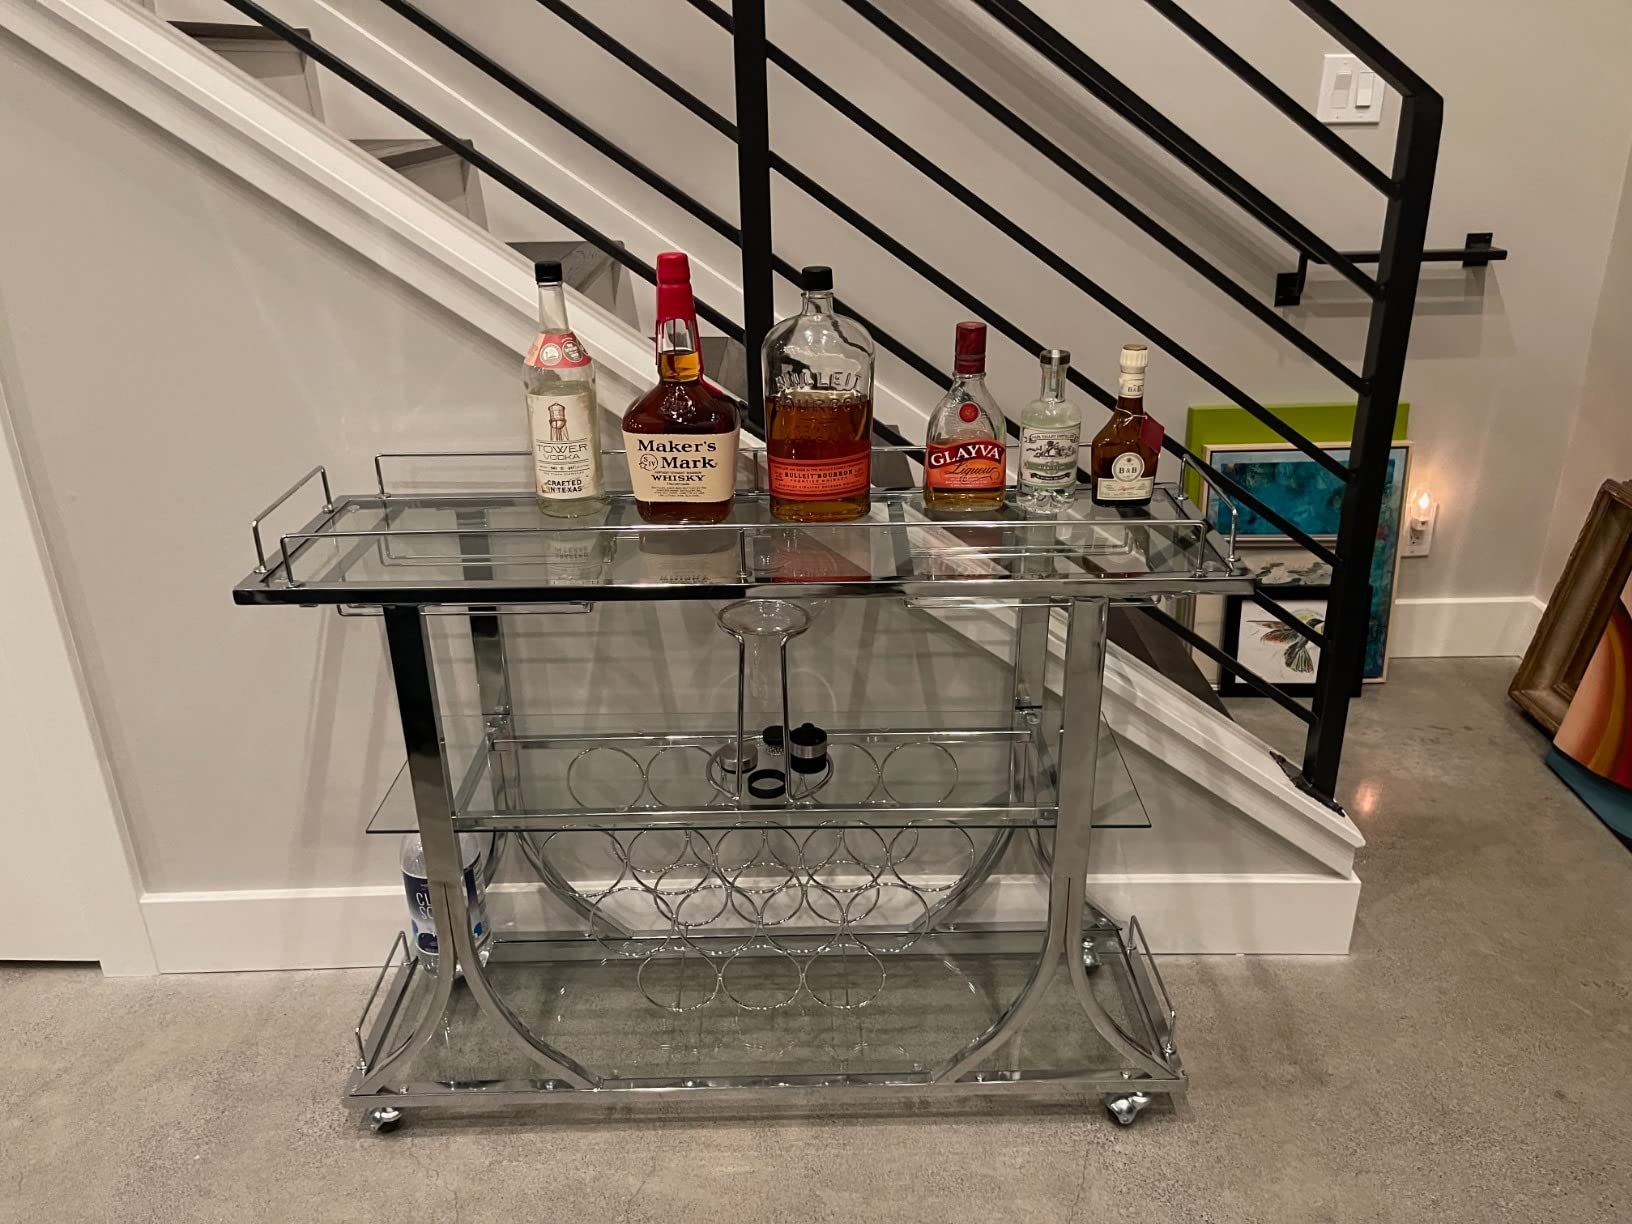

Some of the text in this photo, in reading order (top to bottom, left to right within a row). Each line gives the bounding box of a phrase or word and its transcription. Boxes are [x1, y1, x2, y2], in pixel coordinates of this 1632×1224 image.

[536, 443, 588, 453] TOWER
[637, 439, 717, 453] Maker's
[930, 444, 1001, 466] GLAYVA
[661, 457, 717, 469] Mark
[944, 460, 995, 476] Liqueur
[784, 469, 853, 479] BULLEIT BOURBON
